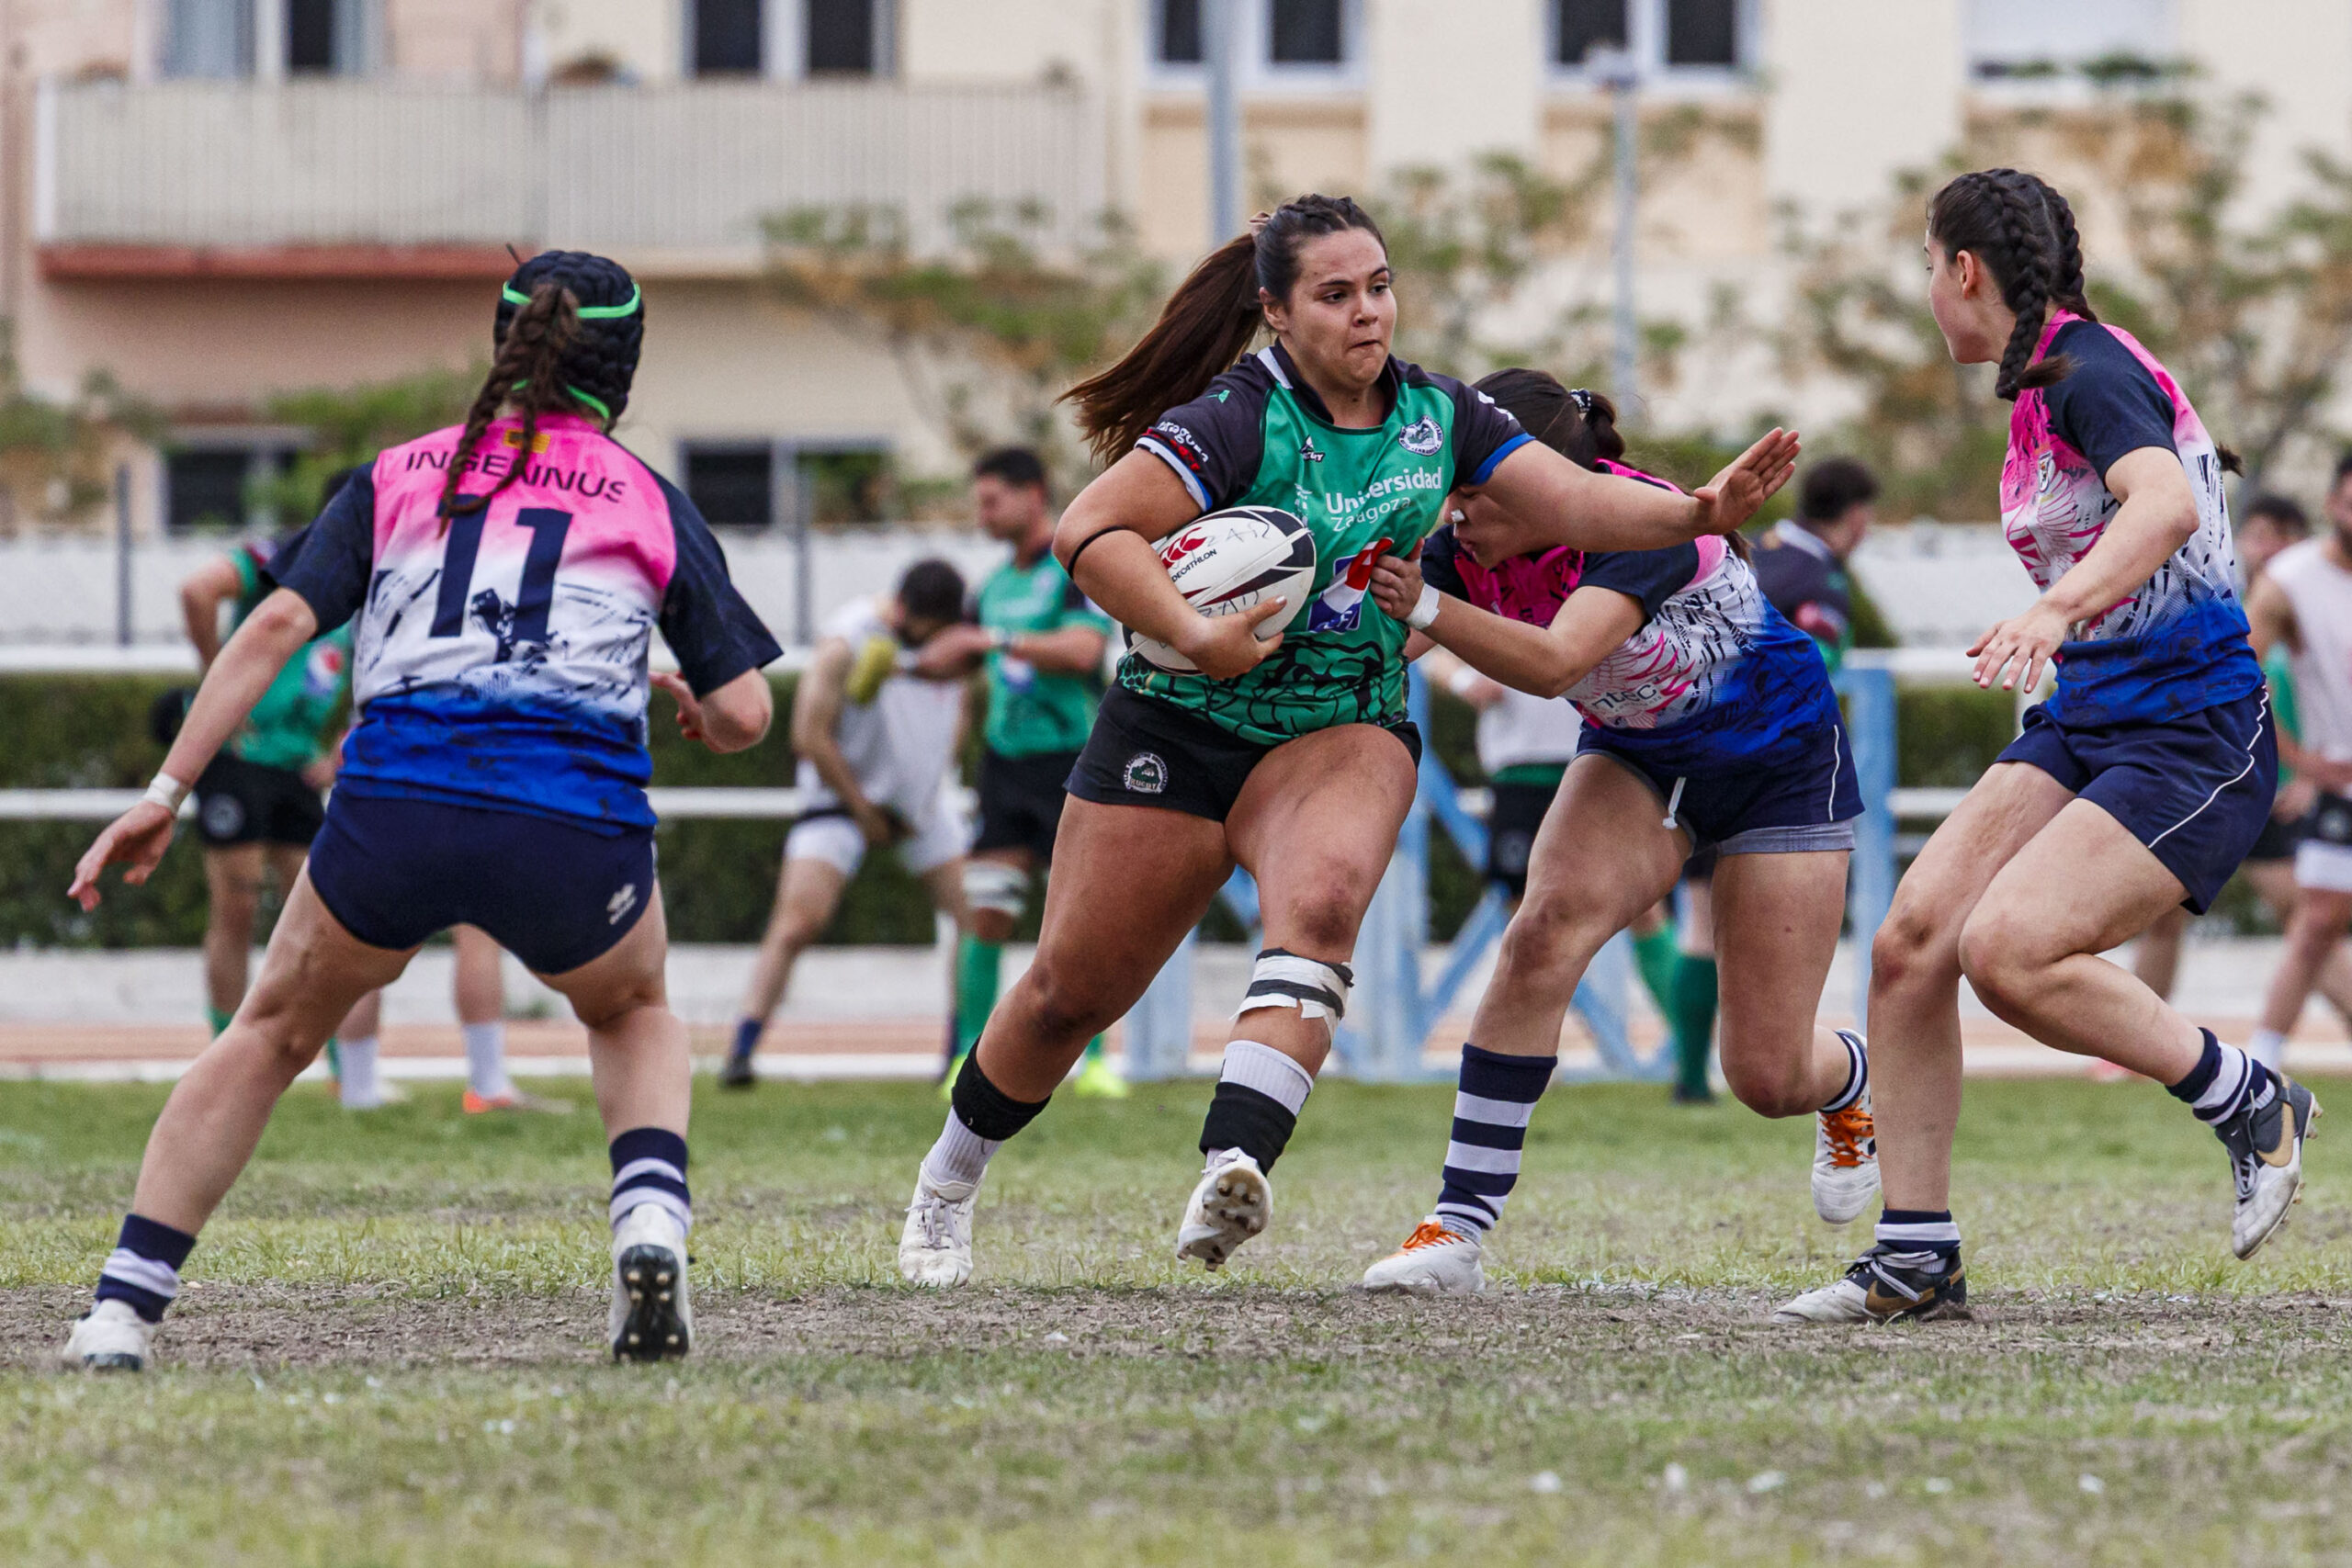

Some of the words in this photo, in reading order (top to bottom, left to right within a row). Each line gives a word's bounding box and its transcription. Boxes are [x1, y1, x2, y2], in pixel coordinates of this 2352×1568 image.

[1330, 496, 1411, 532] Zaagoza
[429, 493, 573, 642] 11
[1171, 548, 1217, 582] DECATHLON
